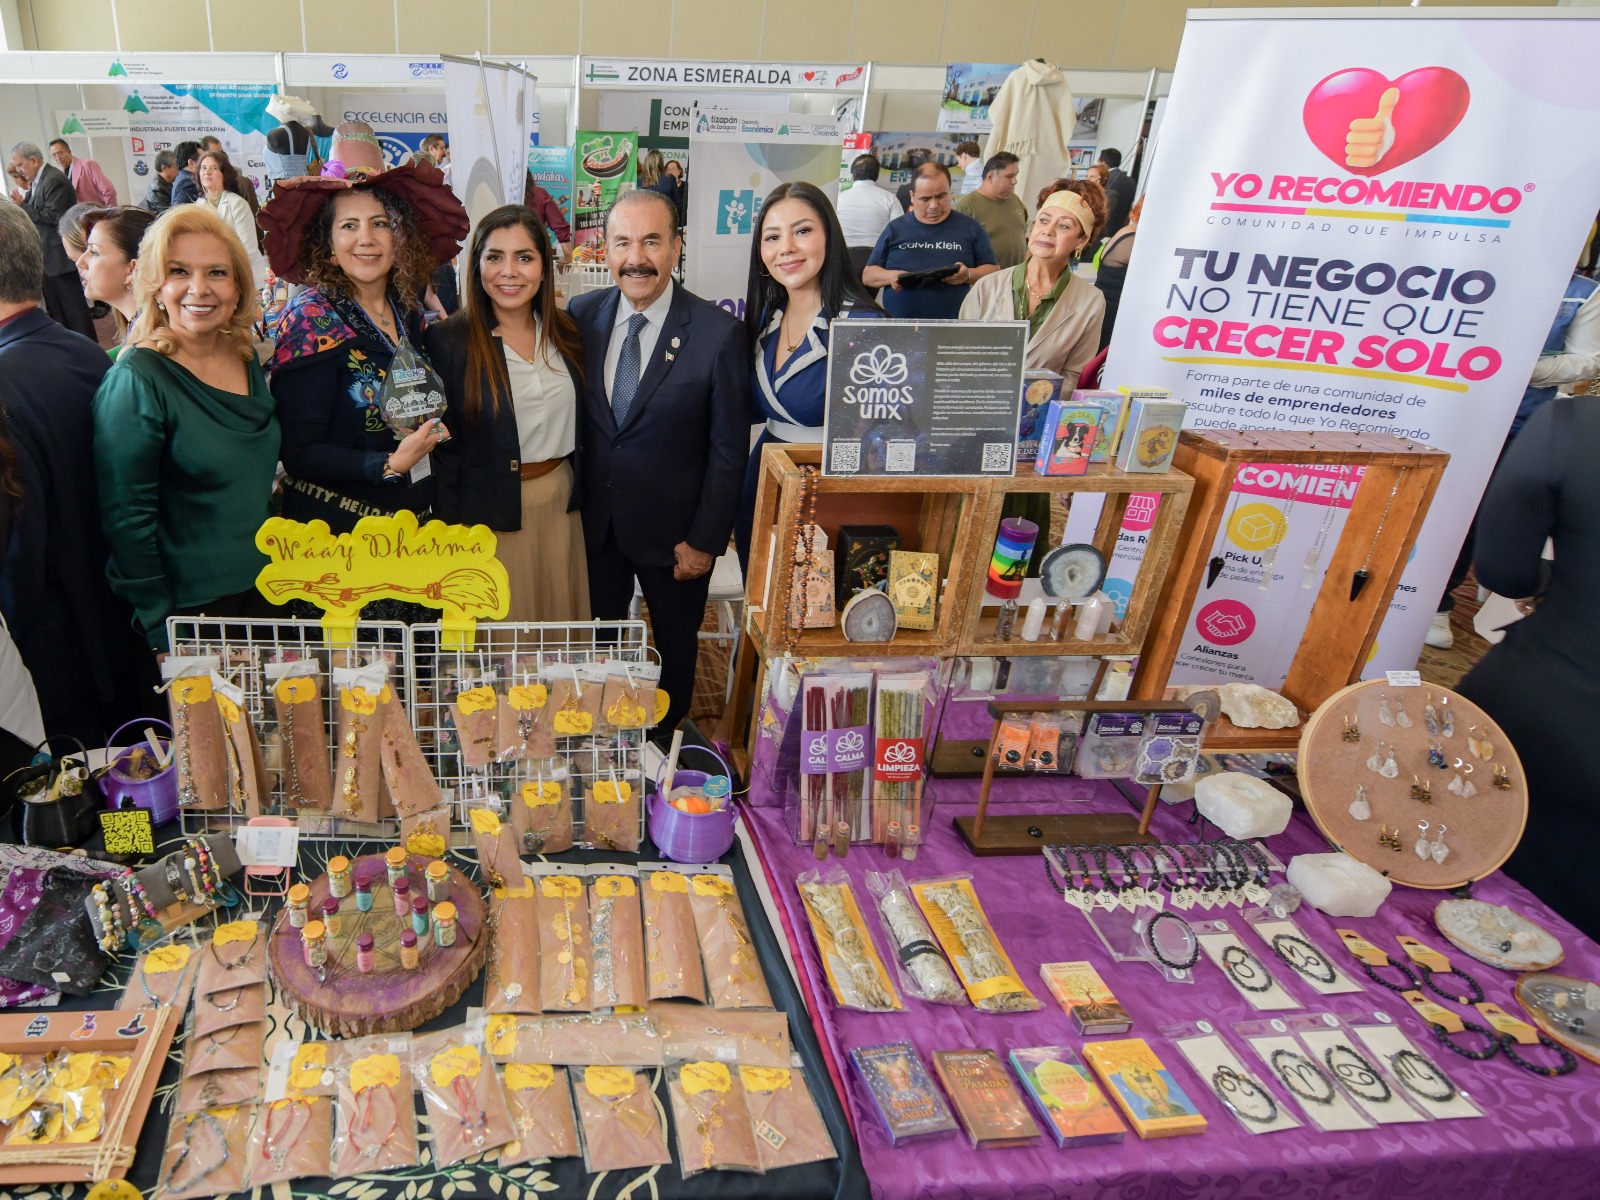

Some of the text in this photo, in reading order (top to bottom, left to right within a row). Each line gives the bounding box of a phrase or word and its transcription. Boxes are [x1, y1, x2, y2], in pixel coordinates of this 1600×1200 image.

[628, 66, 791, 85] ZONA ESMERALDA
[344, 111, 448, 124] EXCELENCIA EN
[742, 125, 774, 133] Económico
[1210, 172, 1262, 200] YO
[1206, 215, 1502, 244] COMUNIDAD QUE IMPULSA
[899, 241, 962, 251] Calvin Klein
[1174, 248, 1496, 304] TU NEGOCIO
[1166, 284, 1485, 339] NO TIENE QUE
[1153, 315, 1502, 381] CRECER SOLO
[842, 386, 914, 405] Somos
[1186, 369, 1427, 408] Forma parte de una comunidad de
[1200, 387, 1397, 419] miles de emprendedores
[860, 404, 903, 421] unx
[1182, 398, 1236, 415] escubre
[1239, 408, 1271, 420] todo
[1273, 411, 1286, 422] lo
[1288, 414, 1315, 426] que
[1319, 416, 1336, 428] Yo
[1339, 419, 1430, 440] Recomiendo
[1194, 417, 1237, 430] puede
[265, 527, 486, 571] Wáay Dharma
[1224, 551, 1248, 564] Pick
[1193, 644, 1239, 660] Alianzas
[1180, 652, 1247, 672] Conexiones para
[1191, 664, 1217, 673] crecer
[1228, 671, 1254, 681] marca
[835, 751, 866, 762] CALMA
[877, 763, 920, 772] LIMPIEZA
[947, 1065, 984, 1077] VIDAS
[958, 1078, 1009, 1089] PASADAS
[1041, 1076, 1084, 1087] CHAKRAS
